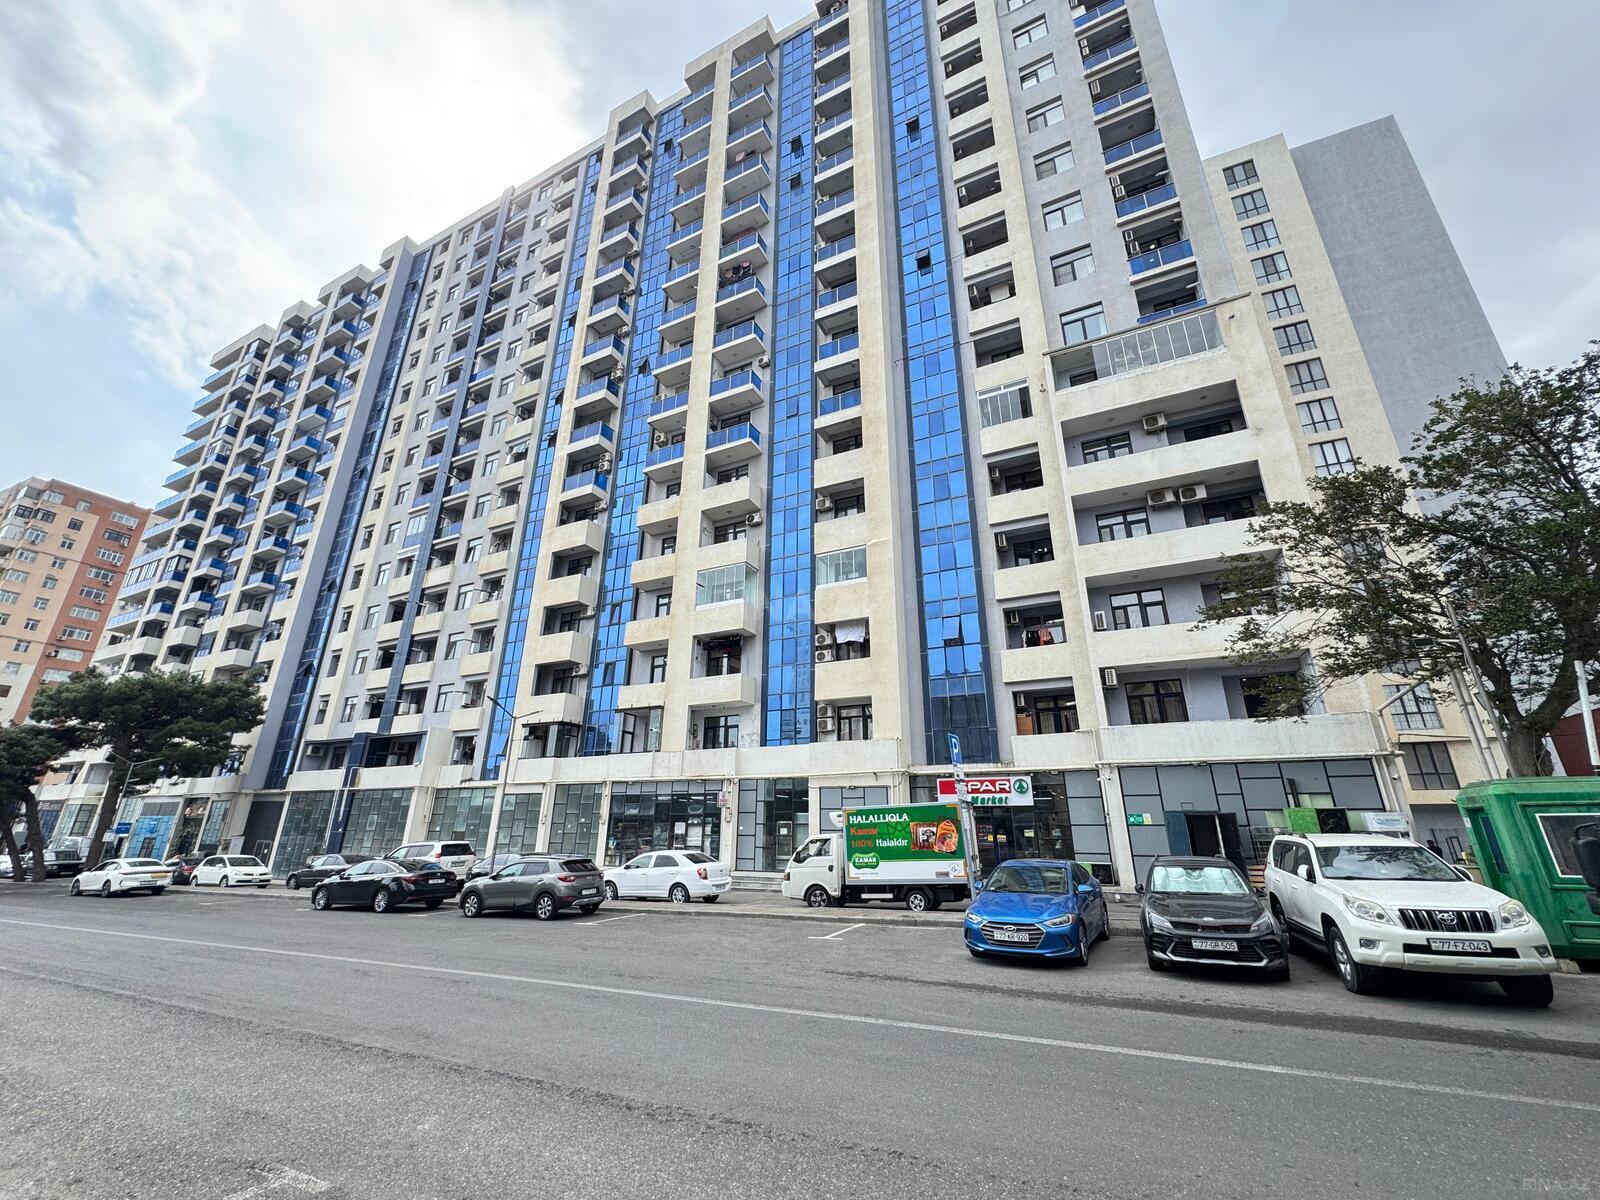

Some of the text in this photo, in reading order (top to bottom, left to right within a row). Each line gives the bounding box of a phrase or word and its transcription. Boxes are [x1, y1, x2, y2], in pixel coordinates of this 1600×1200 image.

[951, 738, 959, 761] P
[971, 795, 1009, 805] Market
[849, 813, 909, 824] HALALLIQLA
[850, 827, 878, 836] Kamar
[851, 840, 874, 848] 100%
[1200, 941, 1236, 950] 77-GR-505
[1439, 941, 1489, 951] 77-FZ-043
